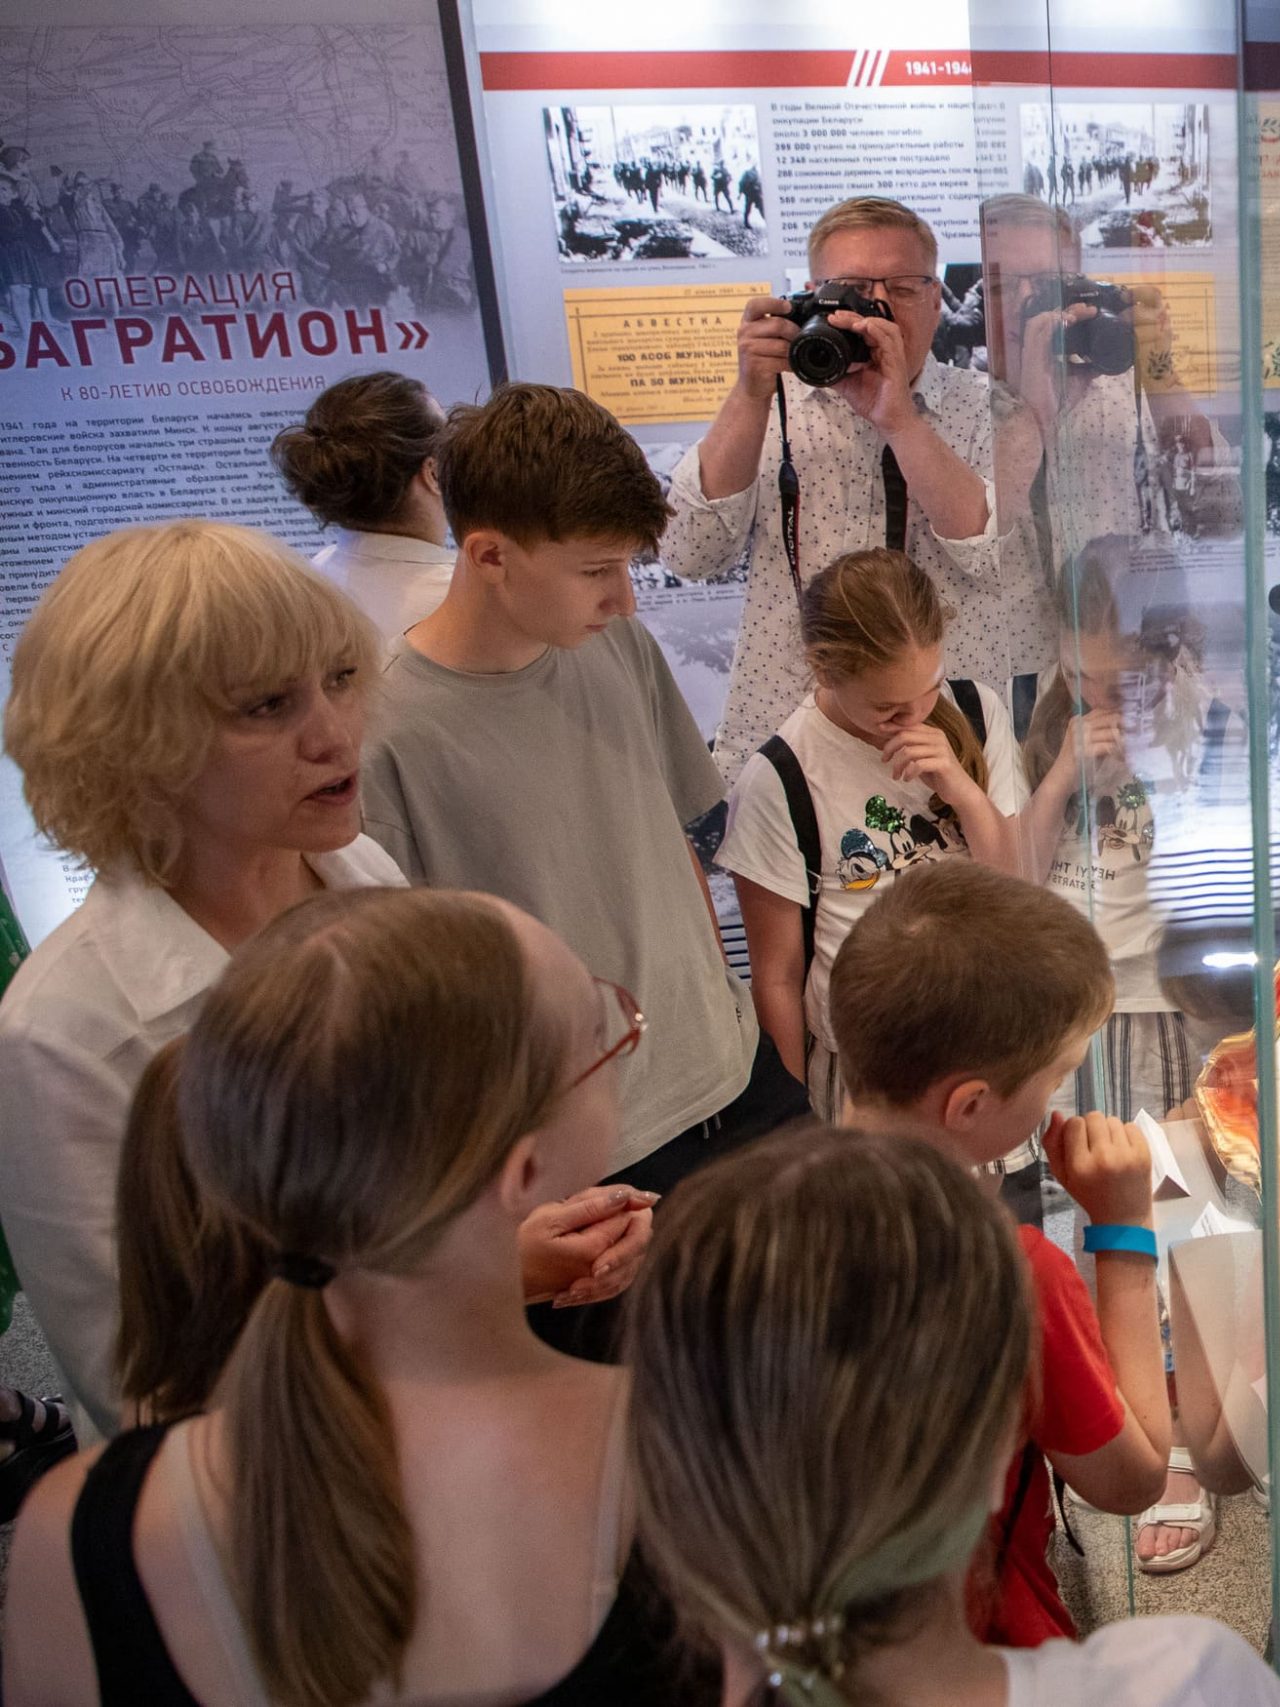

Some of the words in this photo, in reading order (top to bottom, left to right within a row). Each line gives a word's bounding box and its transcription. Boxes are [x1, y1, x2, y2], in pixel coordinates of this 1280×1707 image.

[65, 272, 297, 309] ОПЕРАЦИЯ
[818, 298, 839, 306] Canon
[61, 387, 75, 402] К
[79, 381, 171, 401] 80-ЛЕТИЮ
[177, 375, 327, 397] ОСВОБОЖДЕНИЯ
[1, 422, 24, 430] 1941
[33, 422, 57, 430] года
[86, 417, 144, 427] территории
[152, 414, 198, 423] Беларуси
[70, 431, 104, 440] войска
[110, 429, 160, 438] захватили
[30, 446, 48, 455] Так
[52, 447, 70, 455] для
[73, 443, 126, 453] белорусов
[32, 484, 56, 492] тыла
[39, 492, 117, 504] оккупационную
[0, 511, 33, 521] ужных
[32, 520, 71, 530] фронта,
[75, 517, 132, 527] подготовка
[27, 533, 70, 541] методом
